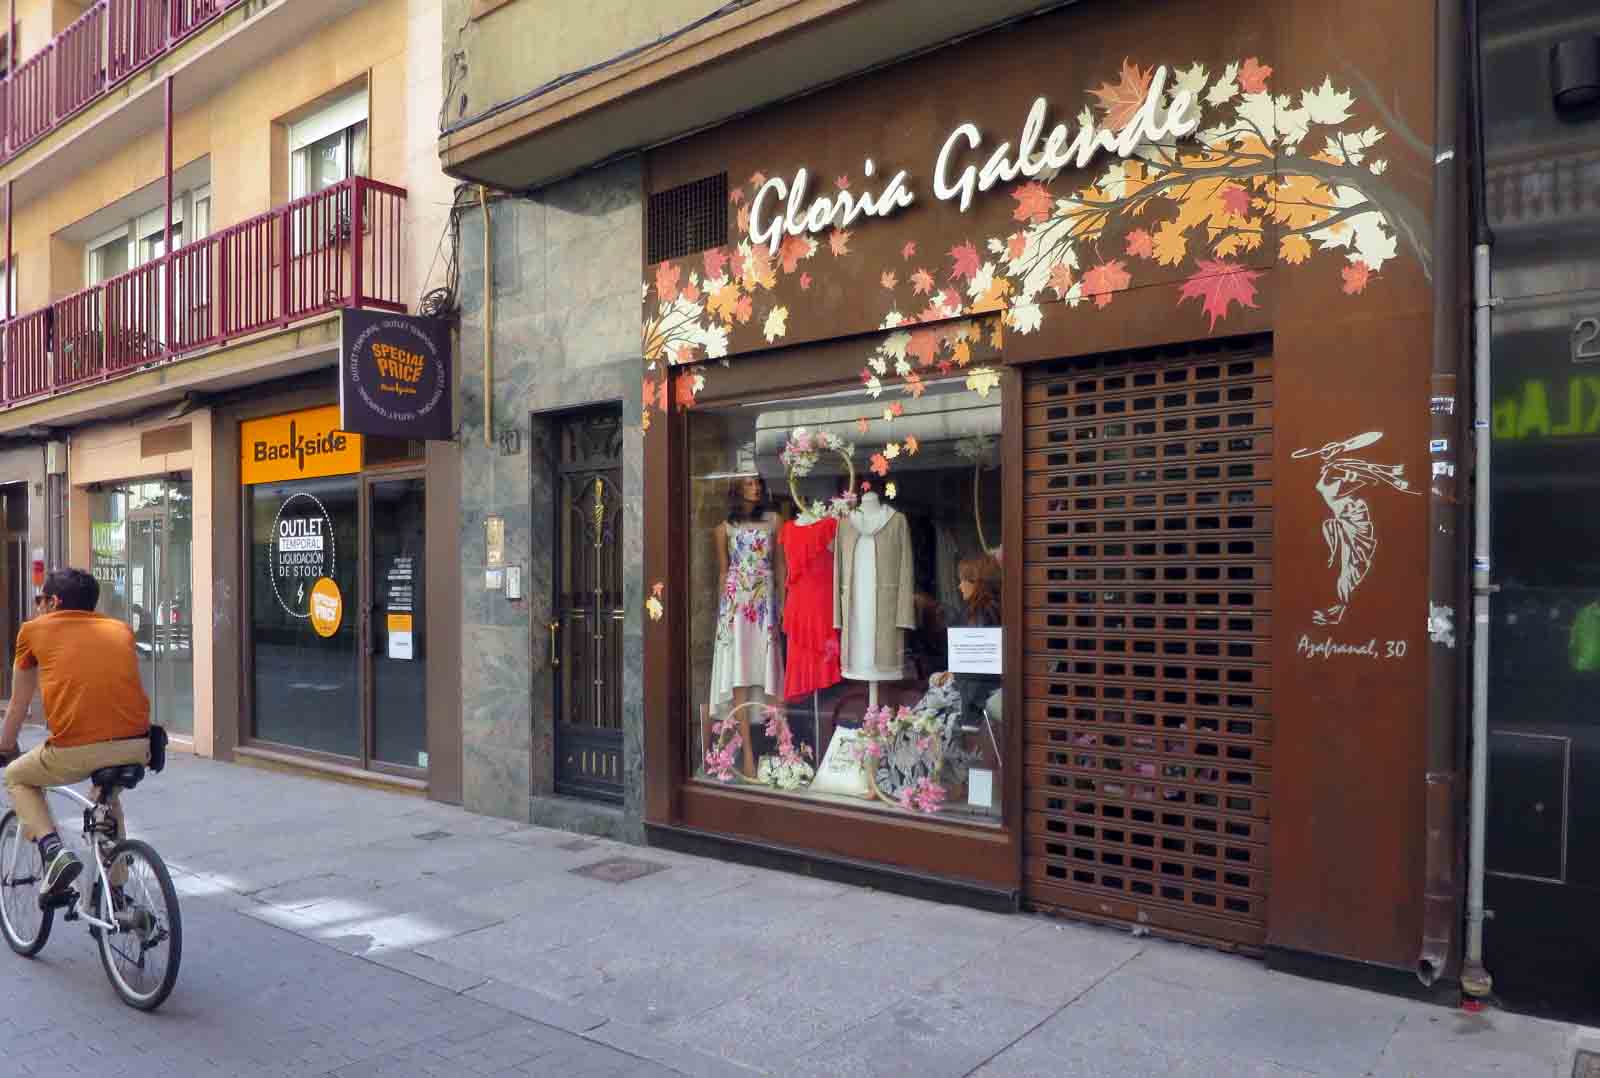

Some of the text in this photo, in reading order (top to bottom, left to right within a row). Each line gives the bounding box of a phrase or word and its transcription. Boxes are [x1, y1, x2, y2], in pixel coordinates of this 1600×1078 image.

[748, 65, 1201, 255] Gloria Galende
[371, 343, 425, 366] SPECIAL
[377, 358, 424, 384] PRICE
[254, 419, 346, 472] Backside
[279, 518, 323, 537] OUTLET
[280, 537, 322, 550] TEMPORAL
[280, 551, 323, 565] LIQUIDACIÓN
[280, 565, 323, 577] DE STOCK
[1384, 640, 1407, 658] 30
